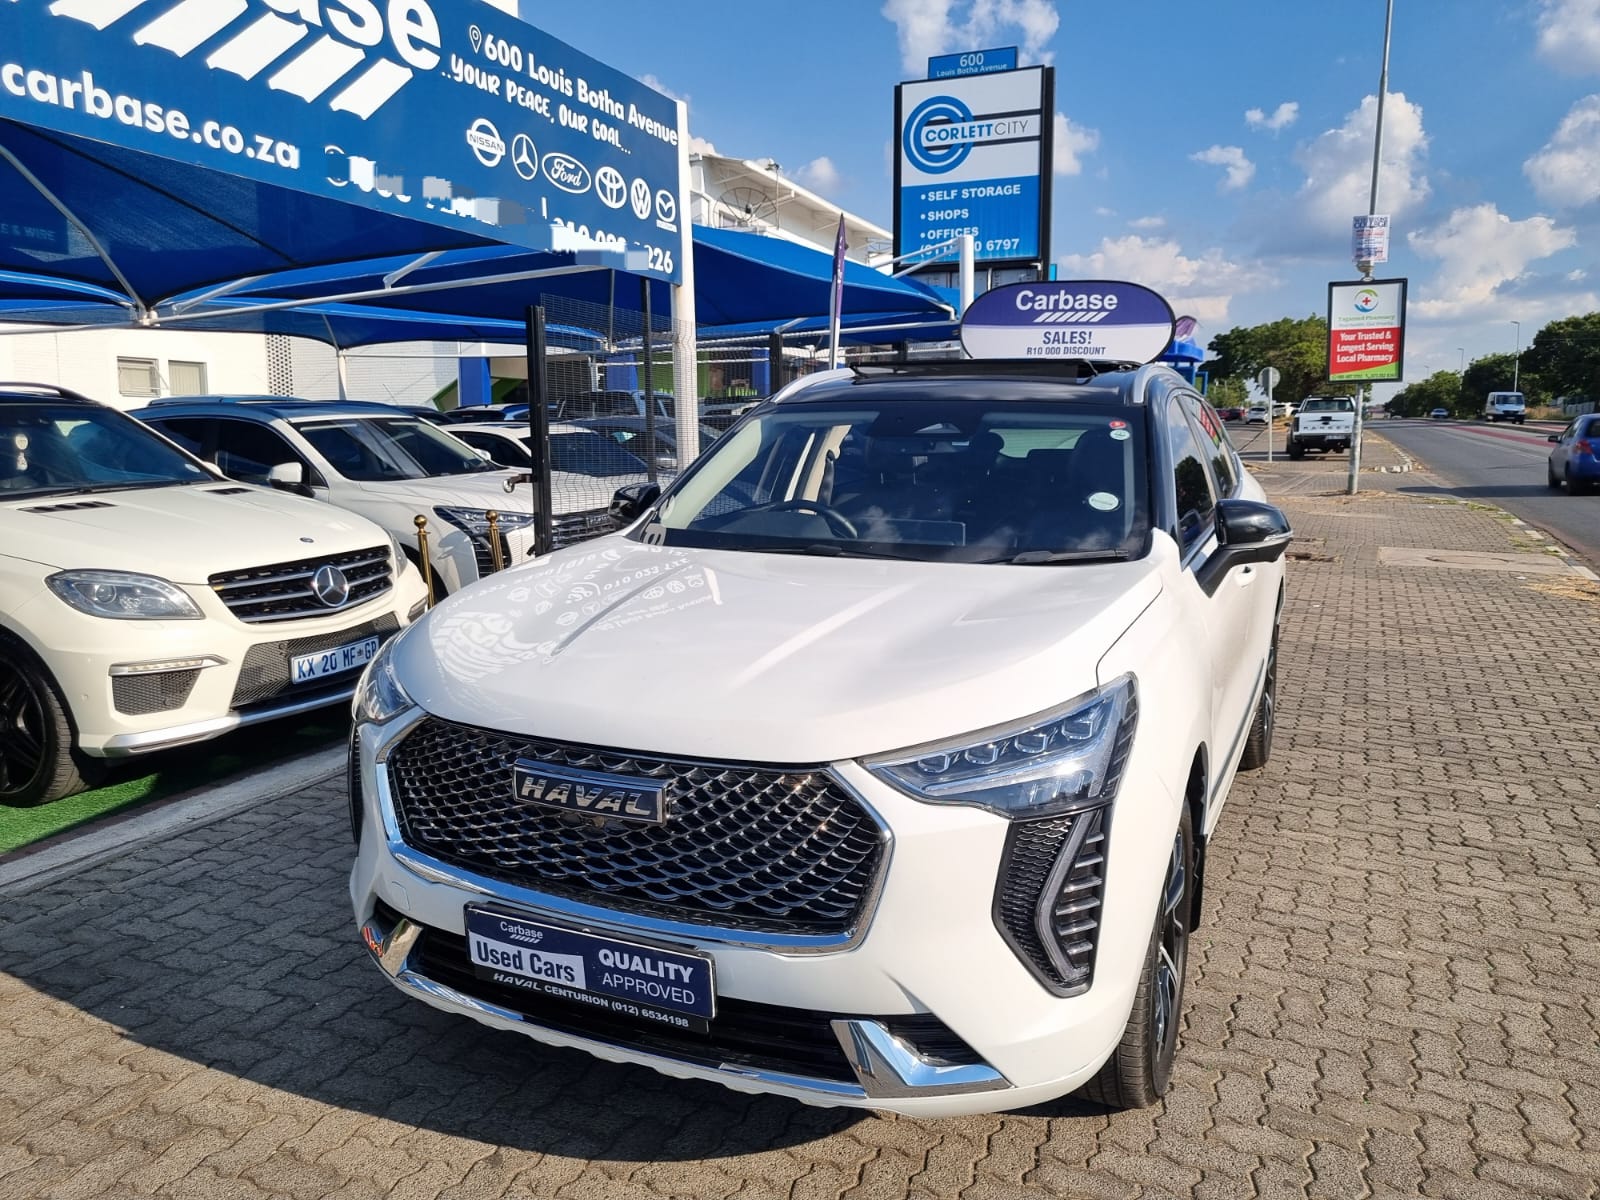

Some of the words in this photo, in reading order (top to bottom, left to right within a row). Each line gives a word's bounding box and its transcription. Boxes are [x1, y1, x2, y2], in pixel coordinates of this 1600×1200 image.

[959, 53, 984, 67] 600
[980, 64, 1008, 72] Avenue
[484, 34, 523, 72] 600
[528, 53, 573, 97] Louis
[577, 78, 624, 120] Botha
[628, 103, 679, 146] Avenue
[1, 62, 300, 170] carbase.co.za
[469, 133, 503, 152] NISSAN
[550, 158, 582, 186] Ford
[927, 189, 957, 201] SELF
[961, 184, 1021, 199] STORAGE
[927, 208, 969, 221] SHOPS
[927, 227, 979, 239] OFFICES
[986, 238, 1019, 250] 6797
[1016, 289, 1118, 311] Carbase
[1042, 331, 1093, 345] SALES!
[1340, 332, 1356, 341] Your
[1358, 331, 1384, 340] Trusted
[1385, 331, 1391, 339] &
[1026, 347, 1043, 355] R10
[1044, 347, 1061, 355] 000
[1063, 346, 1106, 355] DISCOUNT
[1337, 343, 1365, 353] Longest
[1367, 342, 1394, 352] Serving
[1337, 353, 1356, 363] Local
[1357, 353, 1393, 363] Pharmacy
[297, 658, 315, 679] KX
[322, 653, 337, 673] 20
[343, 647, 356, 667] MF
[364, 640, 377, 659] GP
[521, 776, 652, 816] HAVAL
[500, 921, 544, 940] Carbase
[476, 940, 523, 971] Used
[529, 953, 576, 983] Cars
[598, 949, 693, 984] QUALITY
[602, 972, 695, 1005] APPROVED
[493, 972, 541, 991] HAVAL
[544, 985, 609, 1007] CENTURION
[611, 1001, 639, 1016] (012)
[641, 1008, 689, 1028] 6534198
